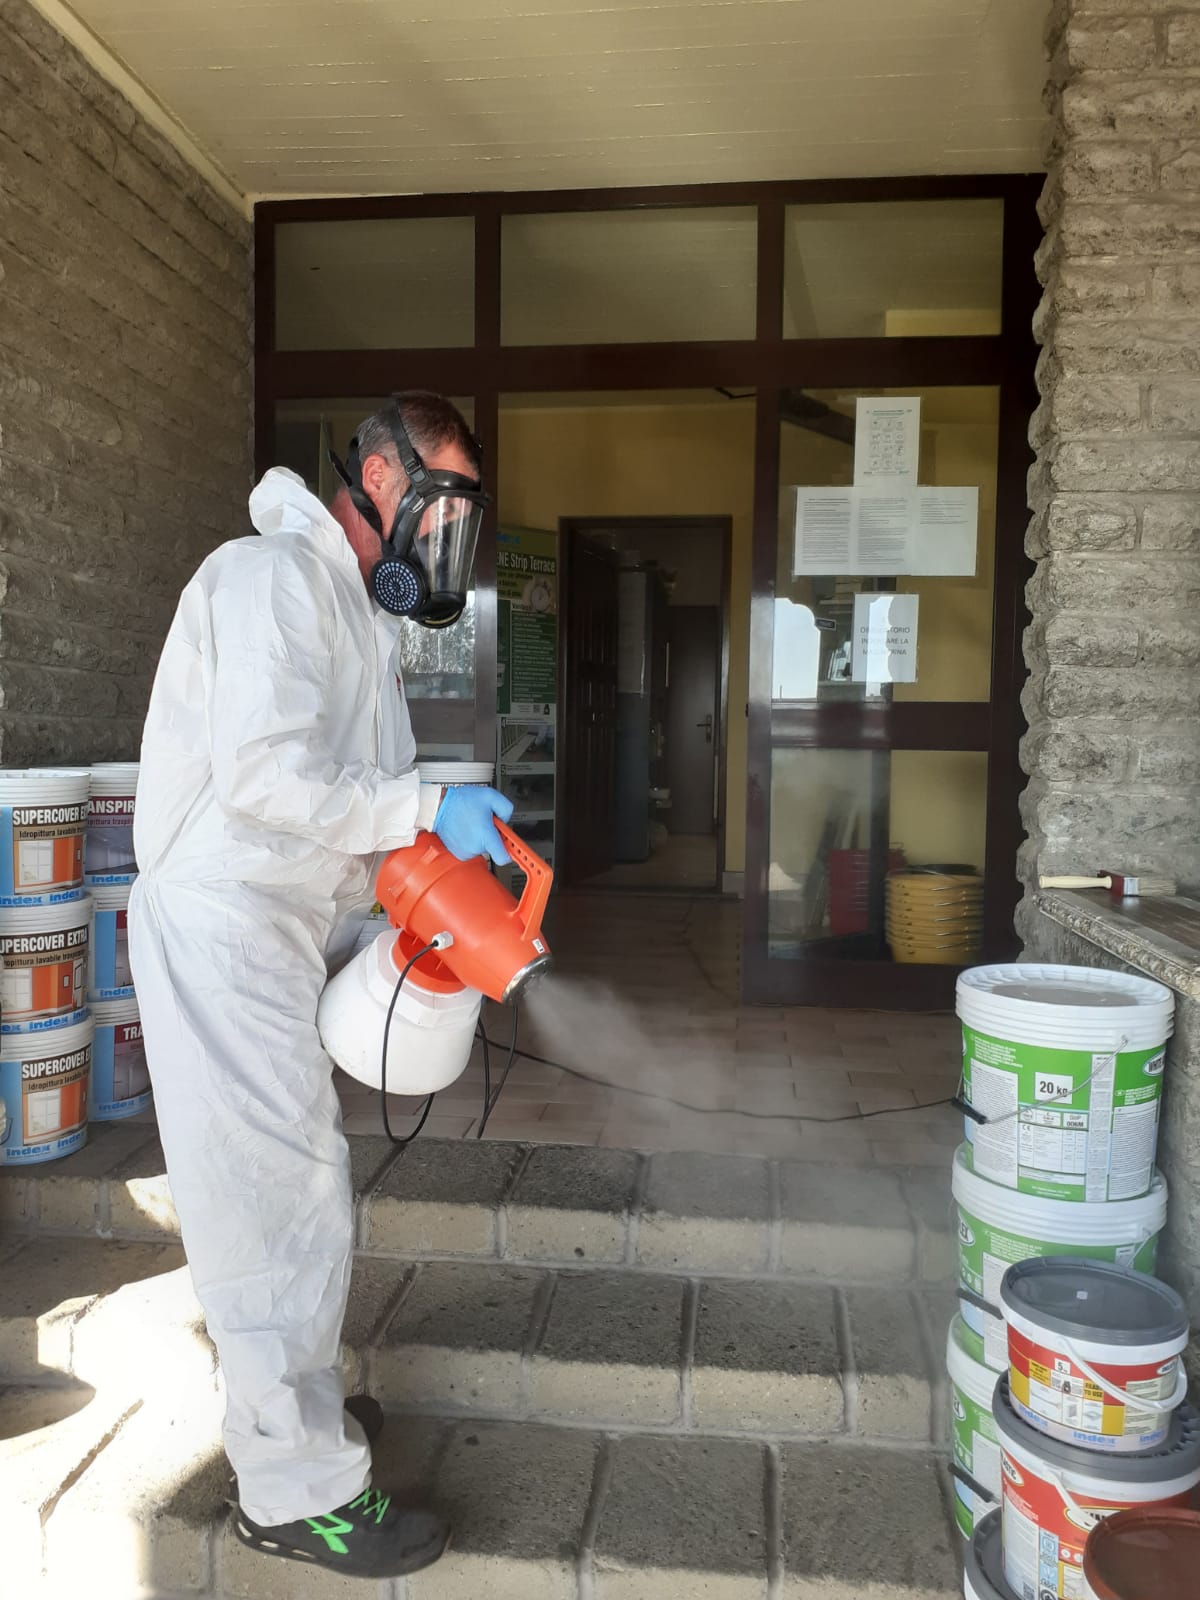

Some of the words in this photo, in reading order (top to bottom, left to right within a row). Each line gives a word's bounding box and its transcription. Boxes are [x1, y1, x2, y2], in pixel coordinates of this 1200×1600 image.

[511, 553, 527, 572] Strip
[529, 556, 555, 573] Terrace
[13, 807, 79, 825] SUPERCOVER
[67, 928, 87, 946] EXTRA
[29, 1017, 68, 1030] index
[22, 1054, 85, 1079] SUPERCOVER
[1039, 1081, 1054, 1094] 20
[1056, 1086, 1068, 1098] kg
[6, 1145, 51, 1156] index
[1057, 1362, 1063, 1371] 5
[1073, 1431, 1116, 1444] index
